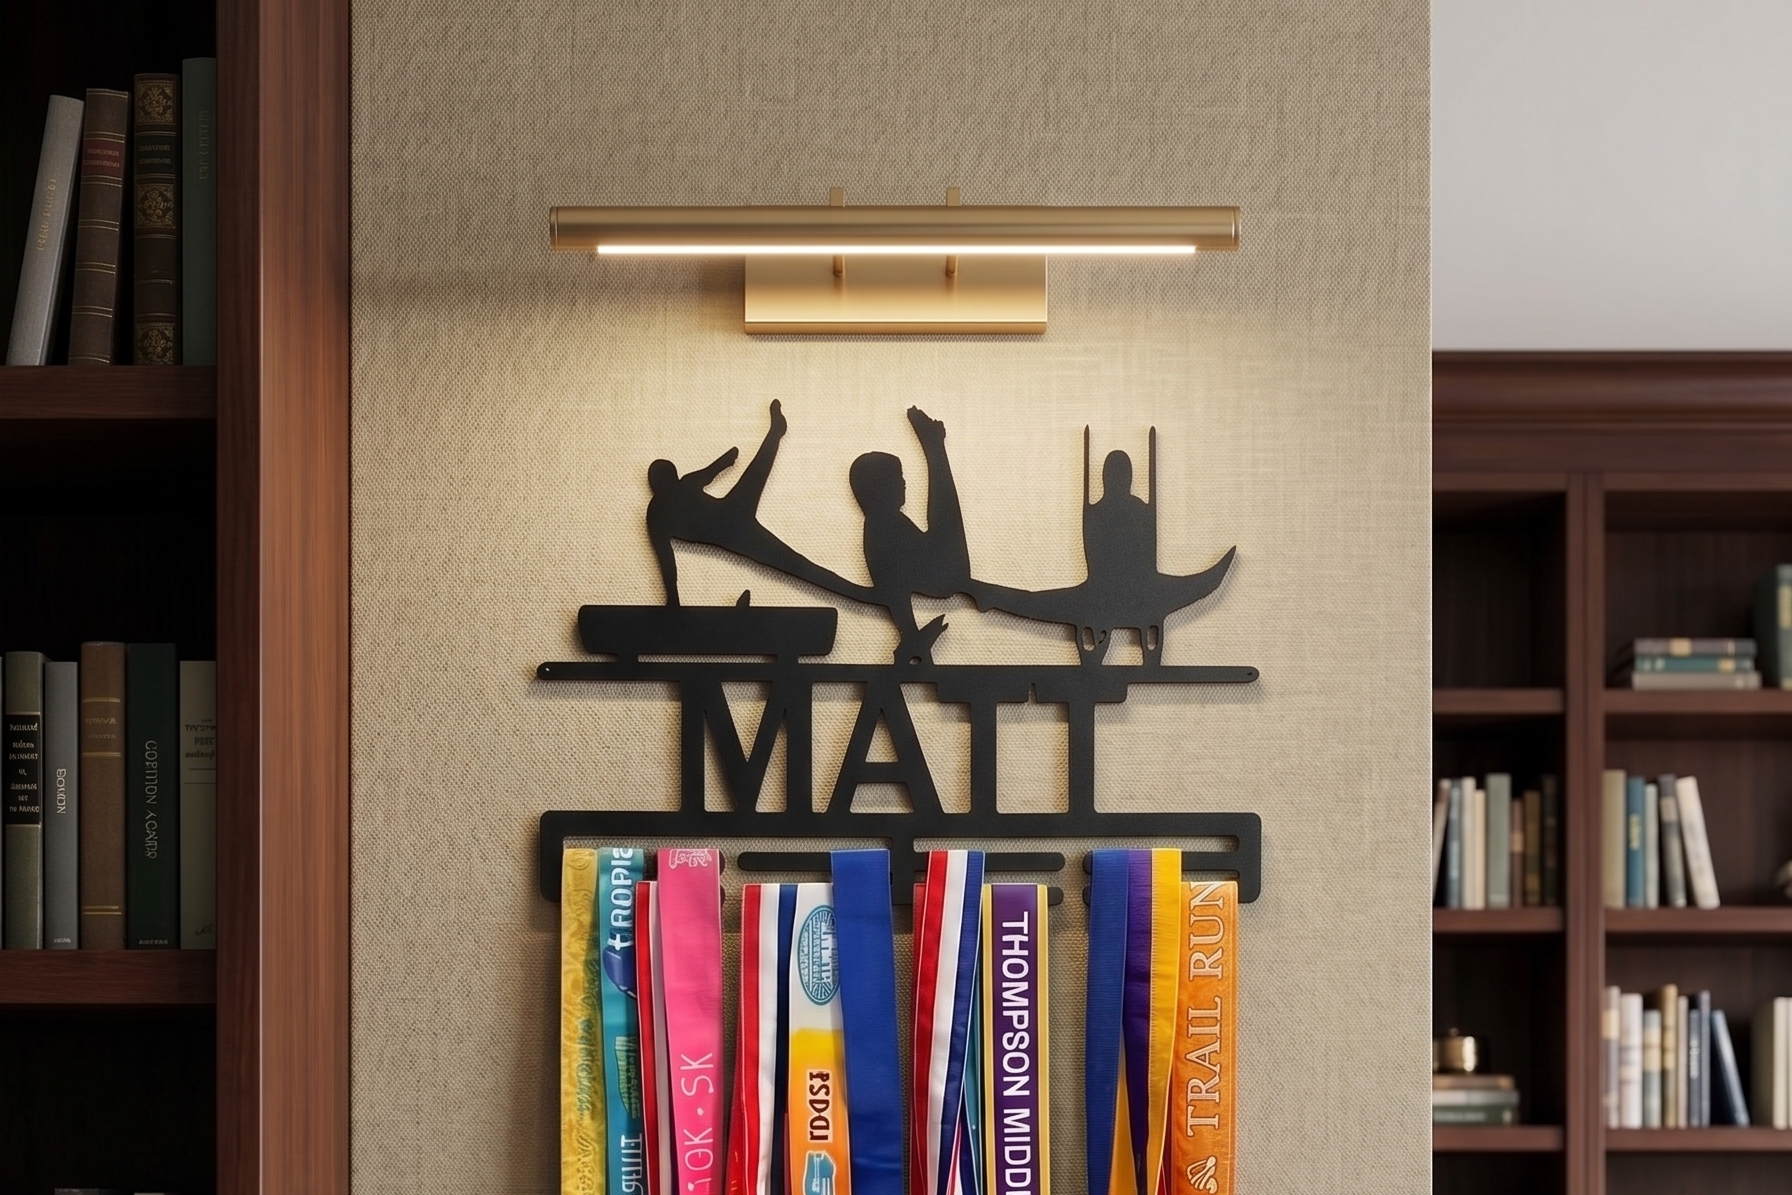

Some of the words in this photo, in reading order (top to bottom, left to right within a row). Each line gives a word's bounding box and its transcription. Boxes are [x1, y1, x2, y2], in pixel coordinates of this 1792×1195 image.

[681, 680, 1127, 815] MATT
[1188, 881, 1225, 981] RUN
[1002, 911, 1031, 1097] THOMPSON
[1185, 996, 1223, 1138] TRAIL
